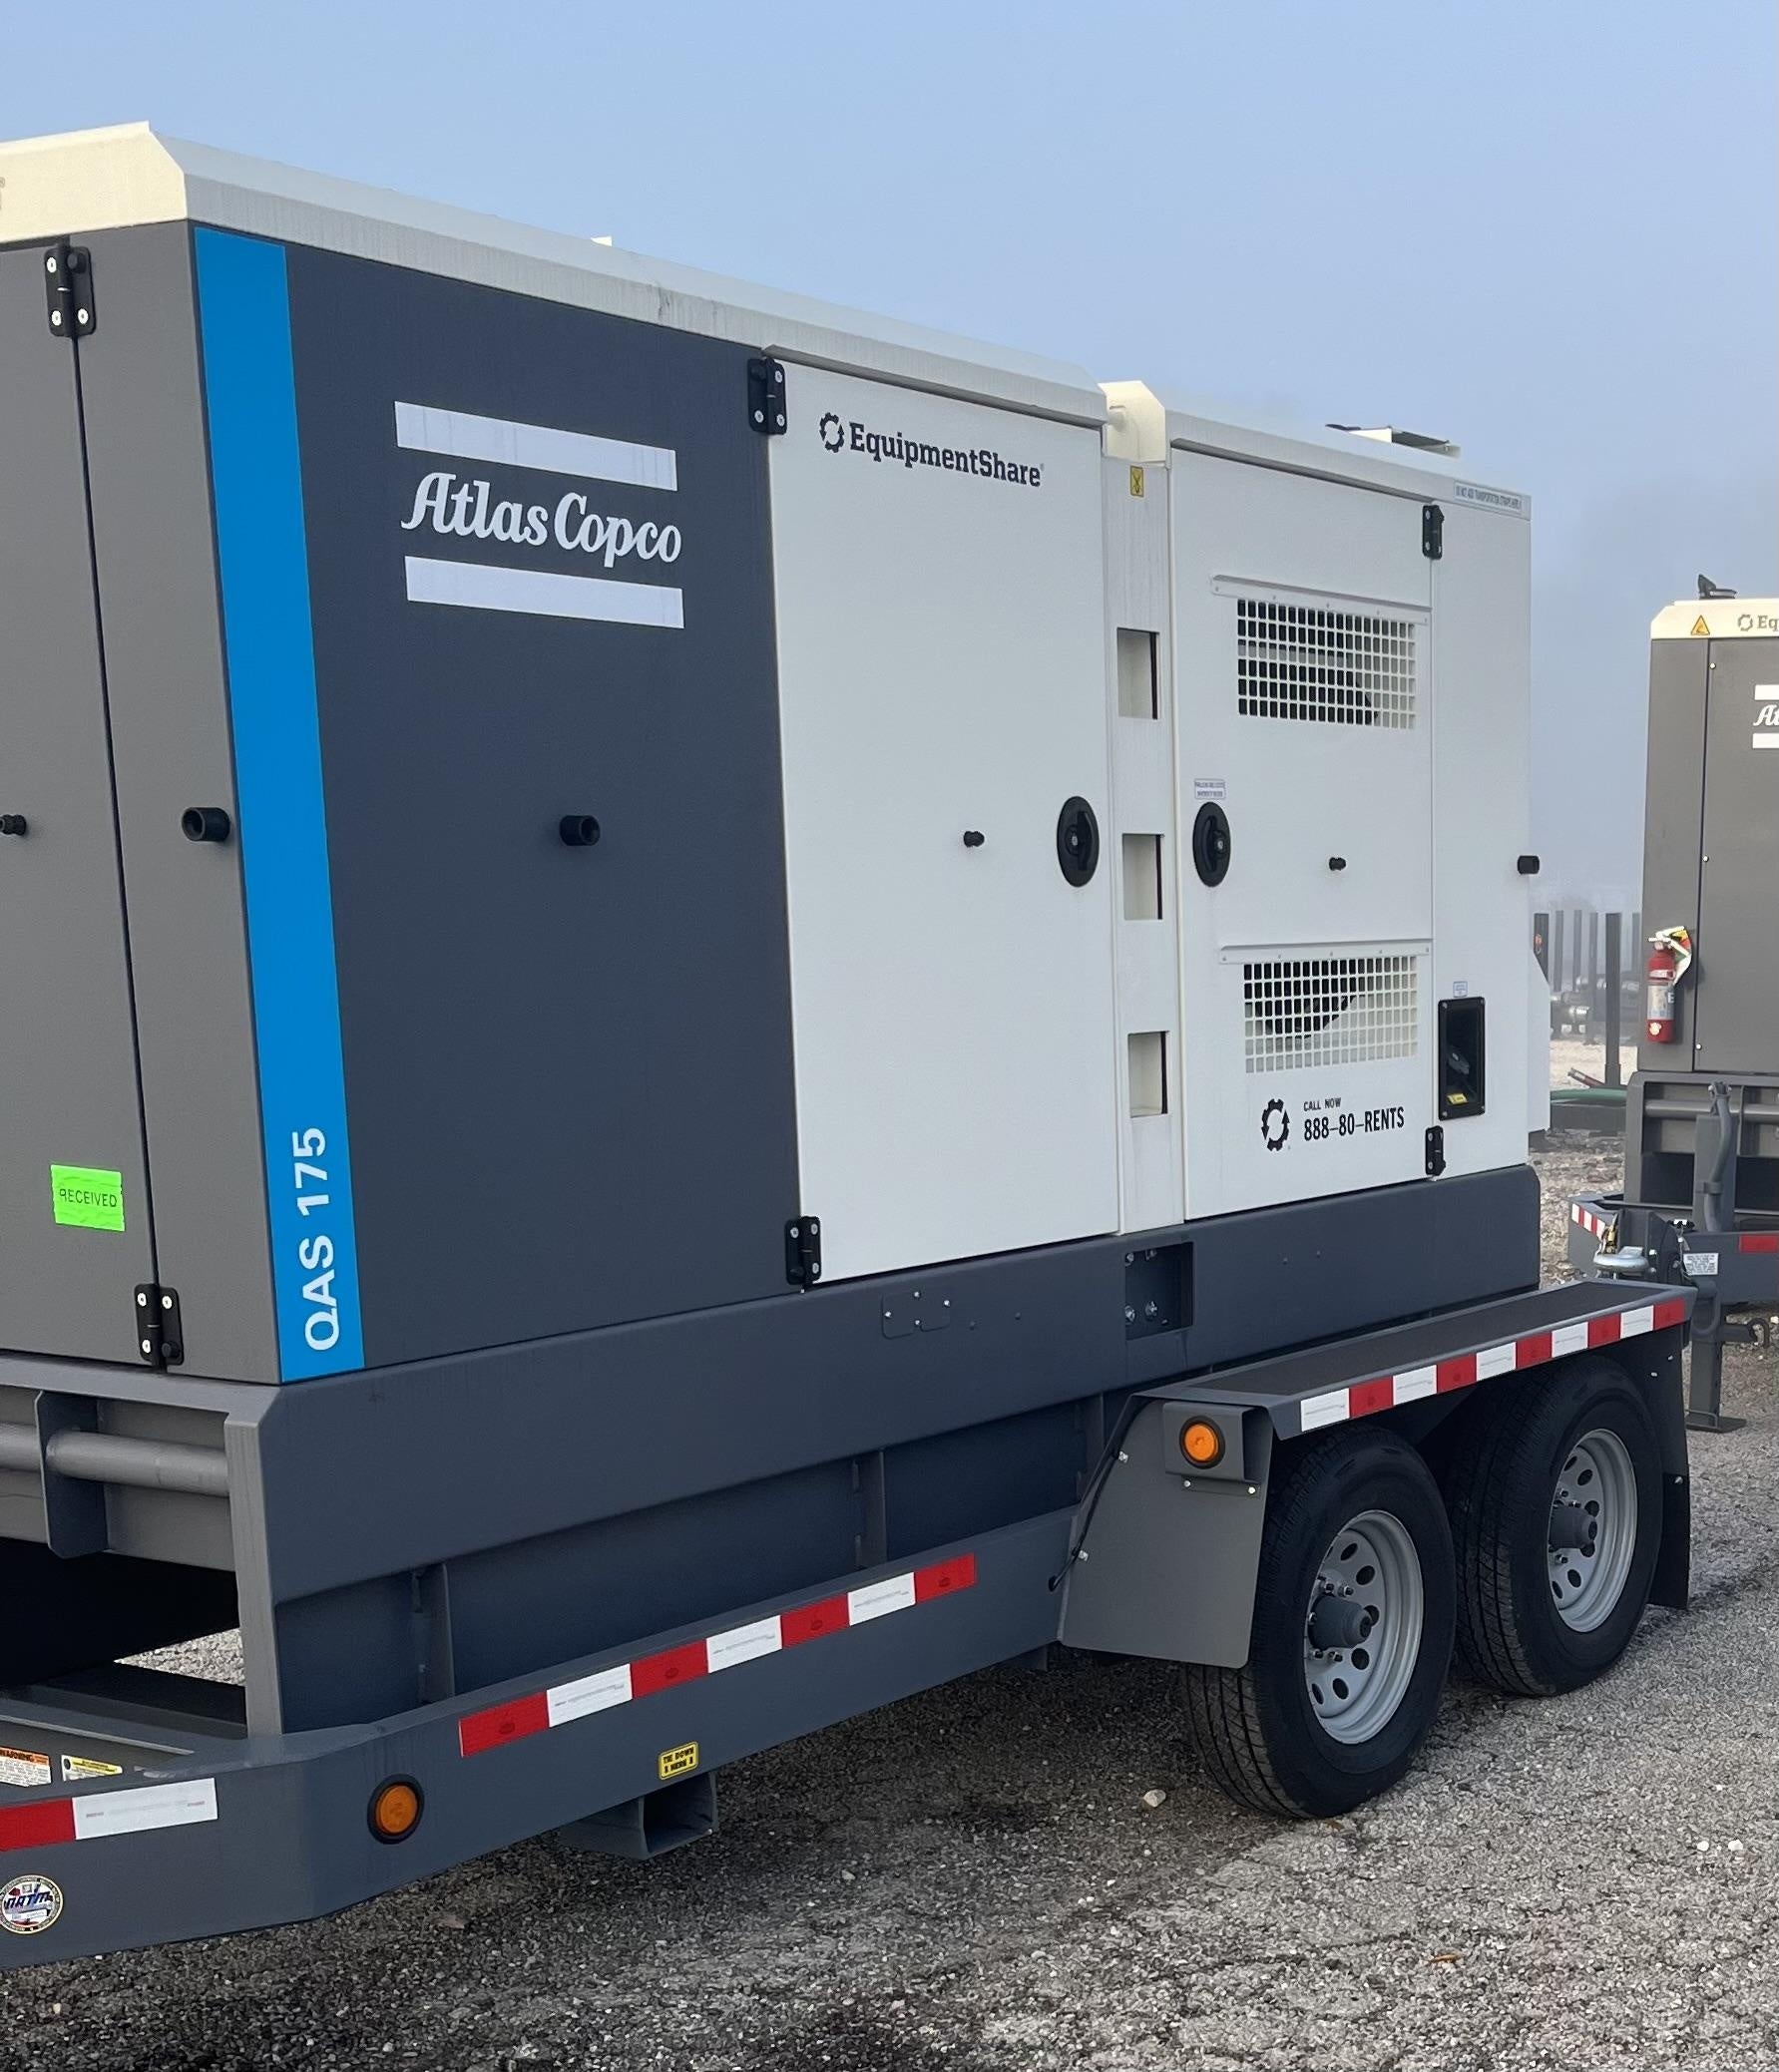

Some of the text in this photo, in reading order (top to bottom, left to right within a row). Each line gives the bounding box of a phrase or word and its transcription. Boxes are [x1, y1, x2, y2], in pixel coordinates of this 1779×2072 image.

[849, 421, 1042, 488] EquipmentShare
[401, 472, 682, 569] Atlas Copco
[1303, 1097, 1342, 1112] CALL NOW
[1304, 1106, 1405, 1141] 888-80-RENTS
[59, 1188, 118, 1208] RECEIVED
[291, 1127, 340, 1351] QAS 175
[675, 1747, 694, 1760] DOWN
